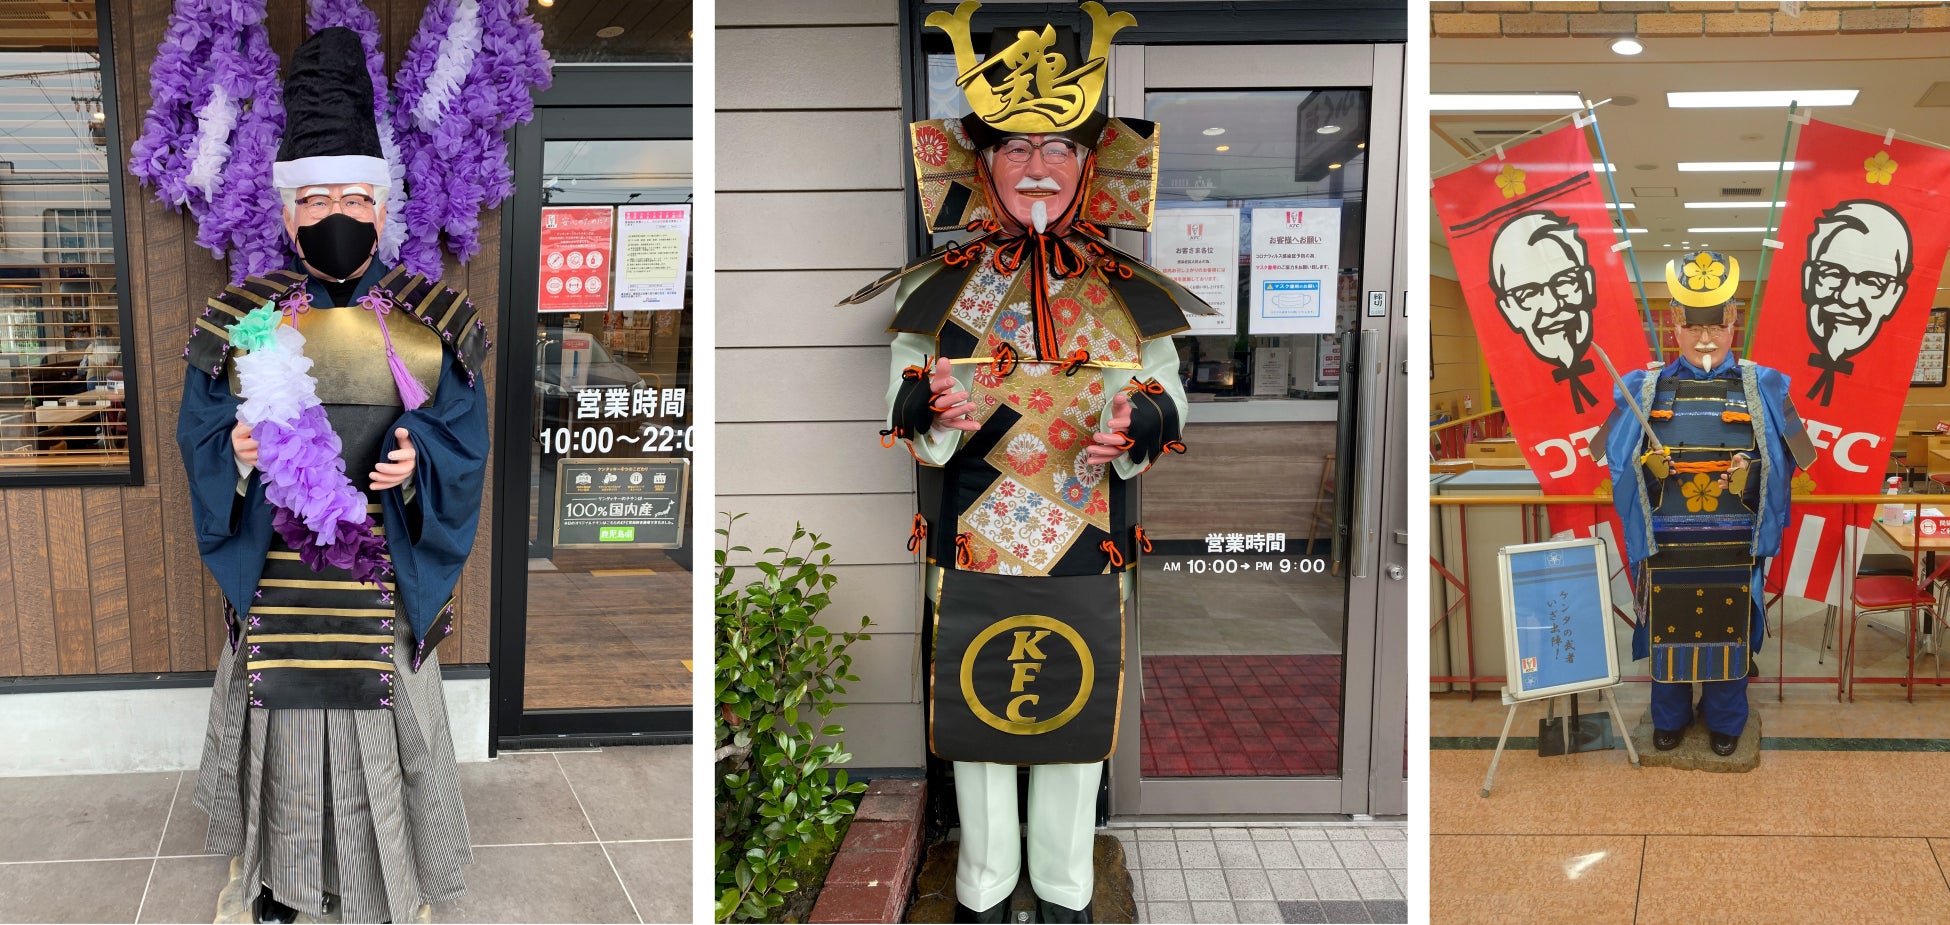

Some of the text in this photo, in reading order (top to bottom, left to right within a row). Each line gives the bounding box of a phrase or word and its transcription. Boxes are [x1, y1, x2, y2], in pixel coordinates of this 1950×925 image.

[1270, 236, 1322, 245] お客様へお願い
[577, 388, 685, 419] 営業時間
[1800, 417, 1880, 473] FC
[1205, 533, 1286, 553] 営業時間
[1163, 558, 1325, 573] AM 10:00 PM 9:00
[1006, 630, 1051, 723] KFC
